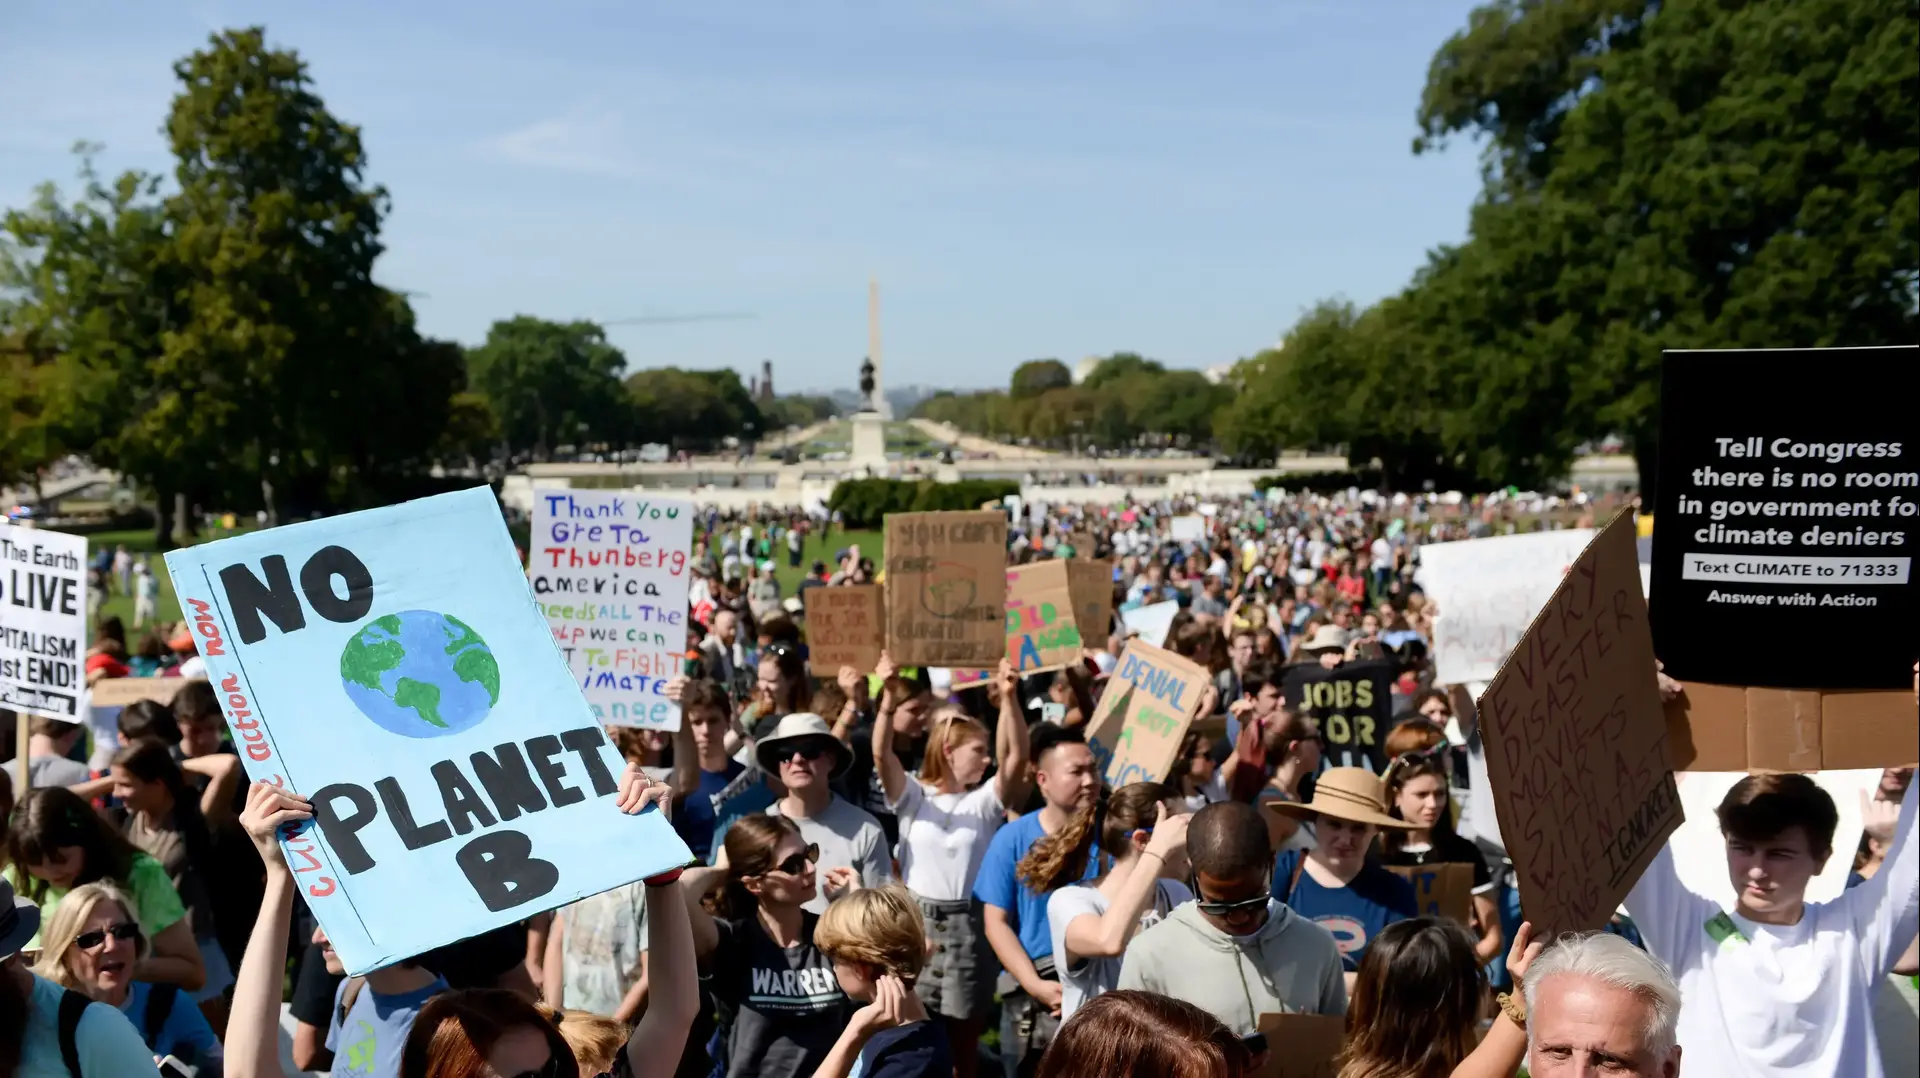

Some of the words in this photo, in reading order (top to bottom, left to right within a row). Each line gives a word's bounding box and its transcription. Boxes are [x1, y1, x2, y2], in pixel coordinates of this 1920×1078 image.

[1716, 436, 1763, 458] Tell
[1770, 437, 1903, 464] Congress
[1692, 466, 1765, 487] there
[1772, 467, 1794, 487] is
[1801, 471, 1837, 487] no
[1844, 471, 1919, 488] room
[544, 495, 625, 519] Thank
[1678, 494, 1703, 514] in
[1710, 499, 1882, 521] government
[1887, 495, 1920, 517] fo
[1694, 523, 1794, 545] climate
[1801, 525, 1906, 546] deniers
[1, 539, 28, 563] The
[33, 544, 79, 571] Earth
[544, 546, 686, 576] Thunberg
[1694, 560, 1730, 574] Text
[1734, 562, 1813, 577] CLIMATE
[1817, 565, 1835, 577] to
[1840, 564, 1899, 577] 71333
[11, 568, 78, 616] LIVE
[218, 545, 374, 645] NO
[1706, 589, 1775, 605] Answer
[1777, 592, 1814, 606] with
[1819, 593, 1878, 607] Action
[598, 604, 633, 621] ALL
[638, 605, 682, 625] The
[626, 628, 665, 646] can
[1492, 551, 1597, 736] EVERY
[27, 656, 77, 690] END!
[1119, 653, 1186, 714] DENIAL
[1503, 588, 1634, 782] DISASTER
[1298, 679, 1374, 712] JOBS
[220, 671, 272, 762] action
[588, 701, 669, 725] ange
[1311, 714, 1376, 747] OR
[1509, 695, 1591, 829] MOVIE
[1615, 749, 1631, 788] A
[1523, 694, 1628, 869] STARTS
[306, 725, 621, 877] PLANET
[259, 773, 337, 898] clime
[455, 829, 559, 913] B
[751, 967, 840, 997] WARREN
